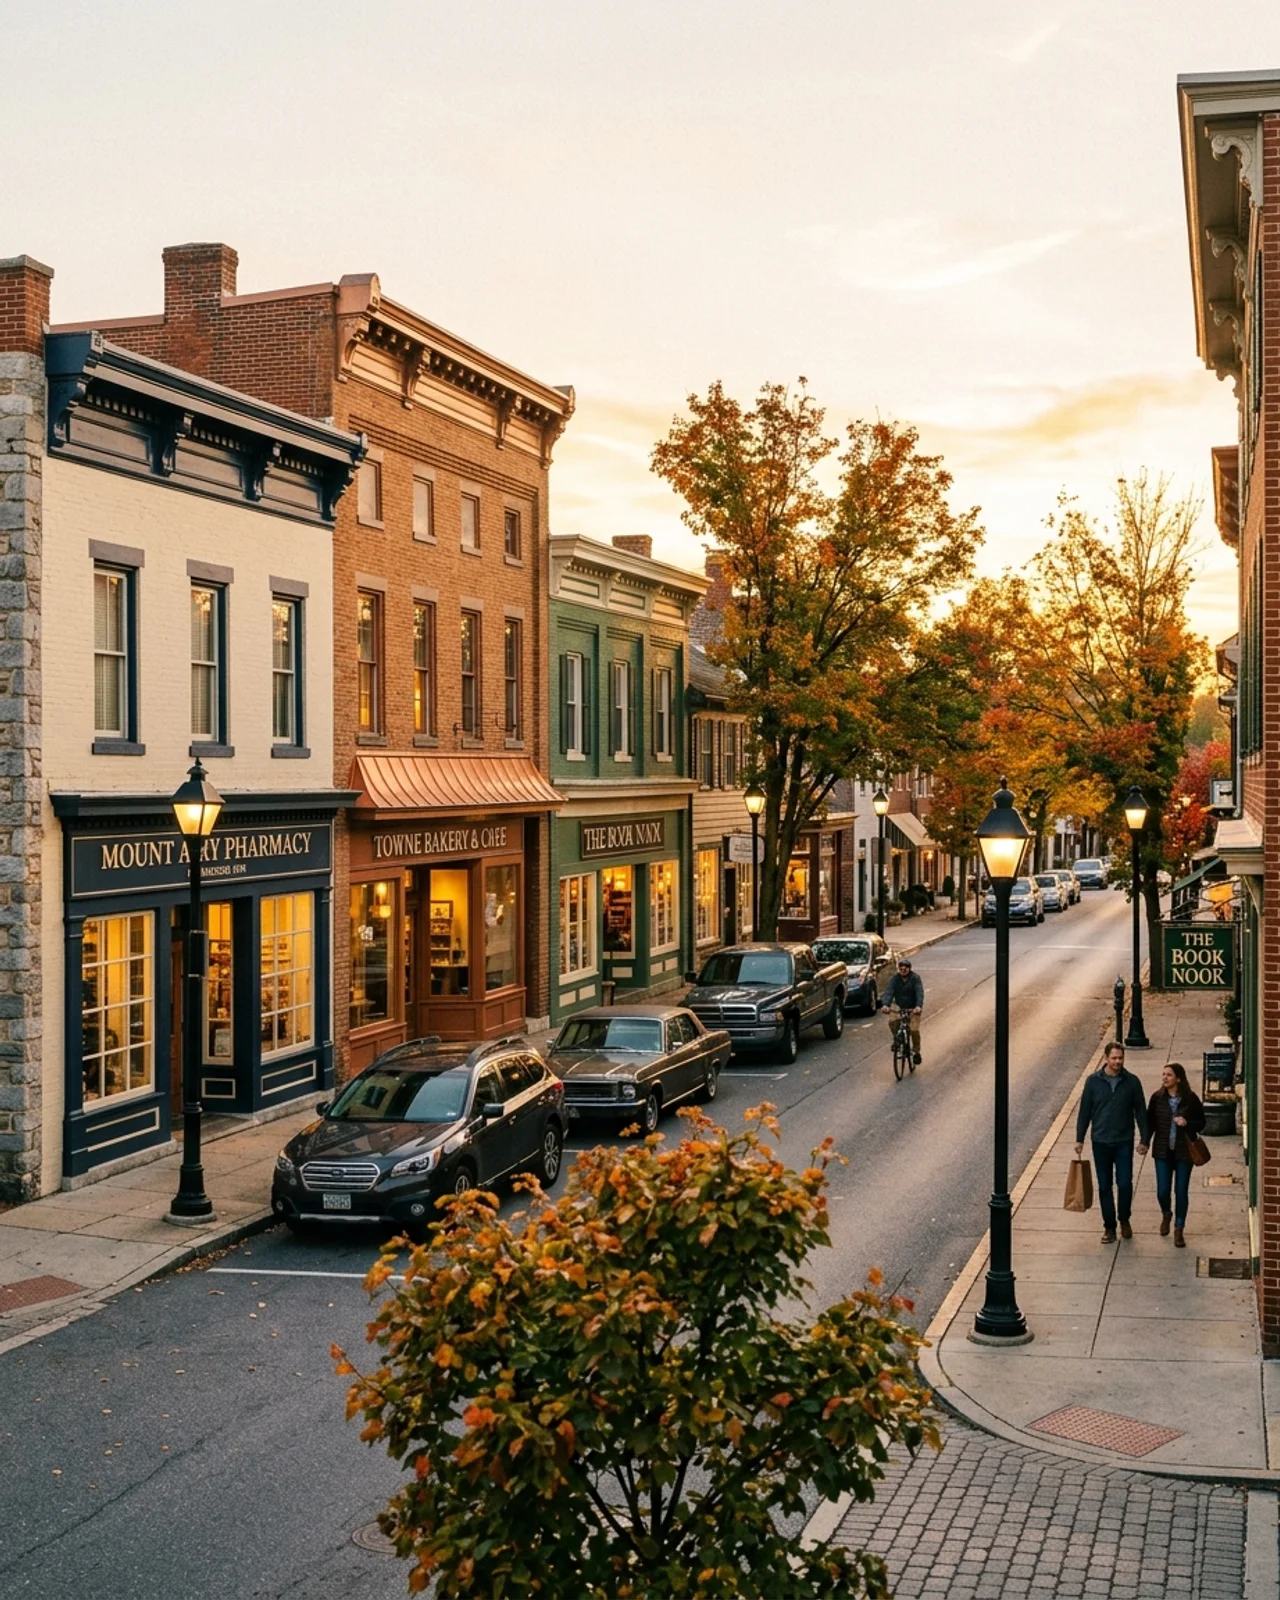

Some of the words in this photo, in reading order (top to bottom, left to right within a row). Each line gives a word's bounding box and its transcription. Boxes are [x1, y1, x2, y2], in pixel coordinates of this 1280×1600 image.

[374, 832, 422, 858] TOWNE
[424, 829, 469, 854] BAKERY
[470, 829, 479, 849] &
[584, 827, 606, 851] THE
[101, 840, 175, 870] MOUNT
[224, 832, 312, 860] PHARMACY
[1181, 932, 1215, 946] THE
[1171, 948, 1226, 967] BOOK
[1171, 967, 1226, 985] NOOK
